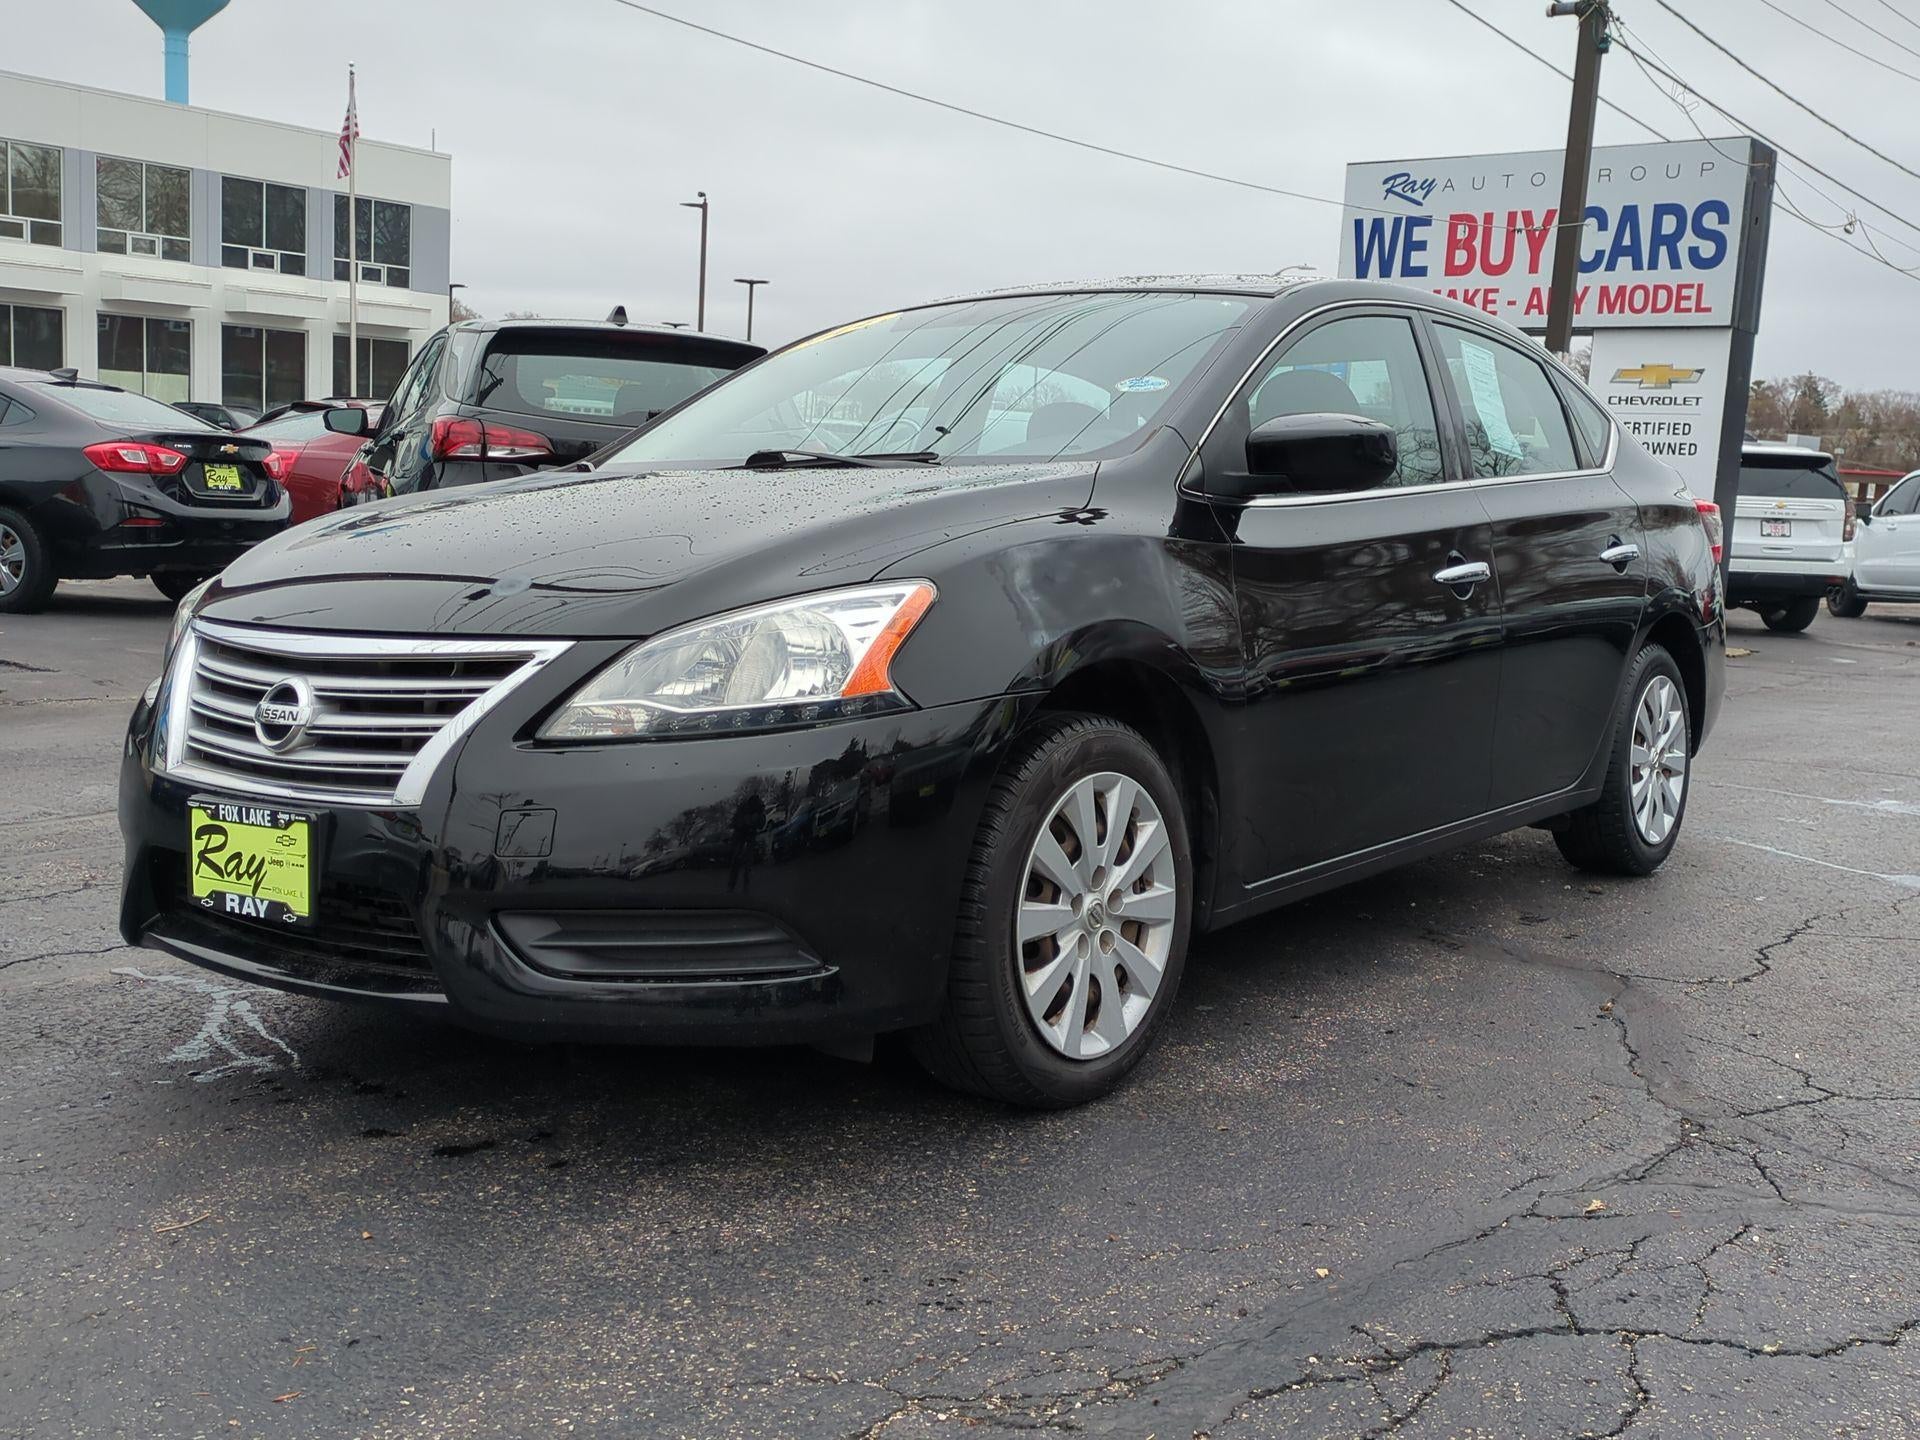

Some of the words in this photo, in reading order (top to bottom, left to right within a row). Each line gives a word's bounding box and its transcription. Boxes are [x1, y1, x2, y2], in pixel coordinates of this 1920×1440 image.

[1382, 172, 1438, 207] Ray
[1442, 171, 1547, 192] AUTO
[1597, 161, 1715, 183] ROUP
[1354, 214, 1433, 279] WE
[1444, 208, 1558, 277] BUY
[1577, 199, 1730, 274] CARS
[1433, 287, 1500, 315] KE
[1524, 285, 1591, 315] AY
[1597, 282, 1713, 315] MODEL
[1607, 395, 1703, 407] CHEVROLET
[1623, 421, 1692, 436] RTIFIED
[207, 469, 228, 485] Ray
[219, 804, 240, 822] FOX
[242, 807, 272, 827] LAKE
[195, 823, 267, 897] Ray
[267, 856, 285, 869] Jeep
[271, 886, 283, 895] FOX
[225, 893, 269, 918] RAY
